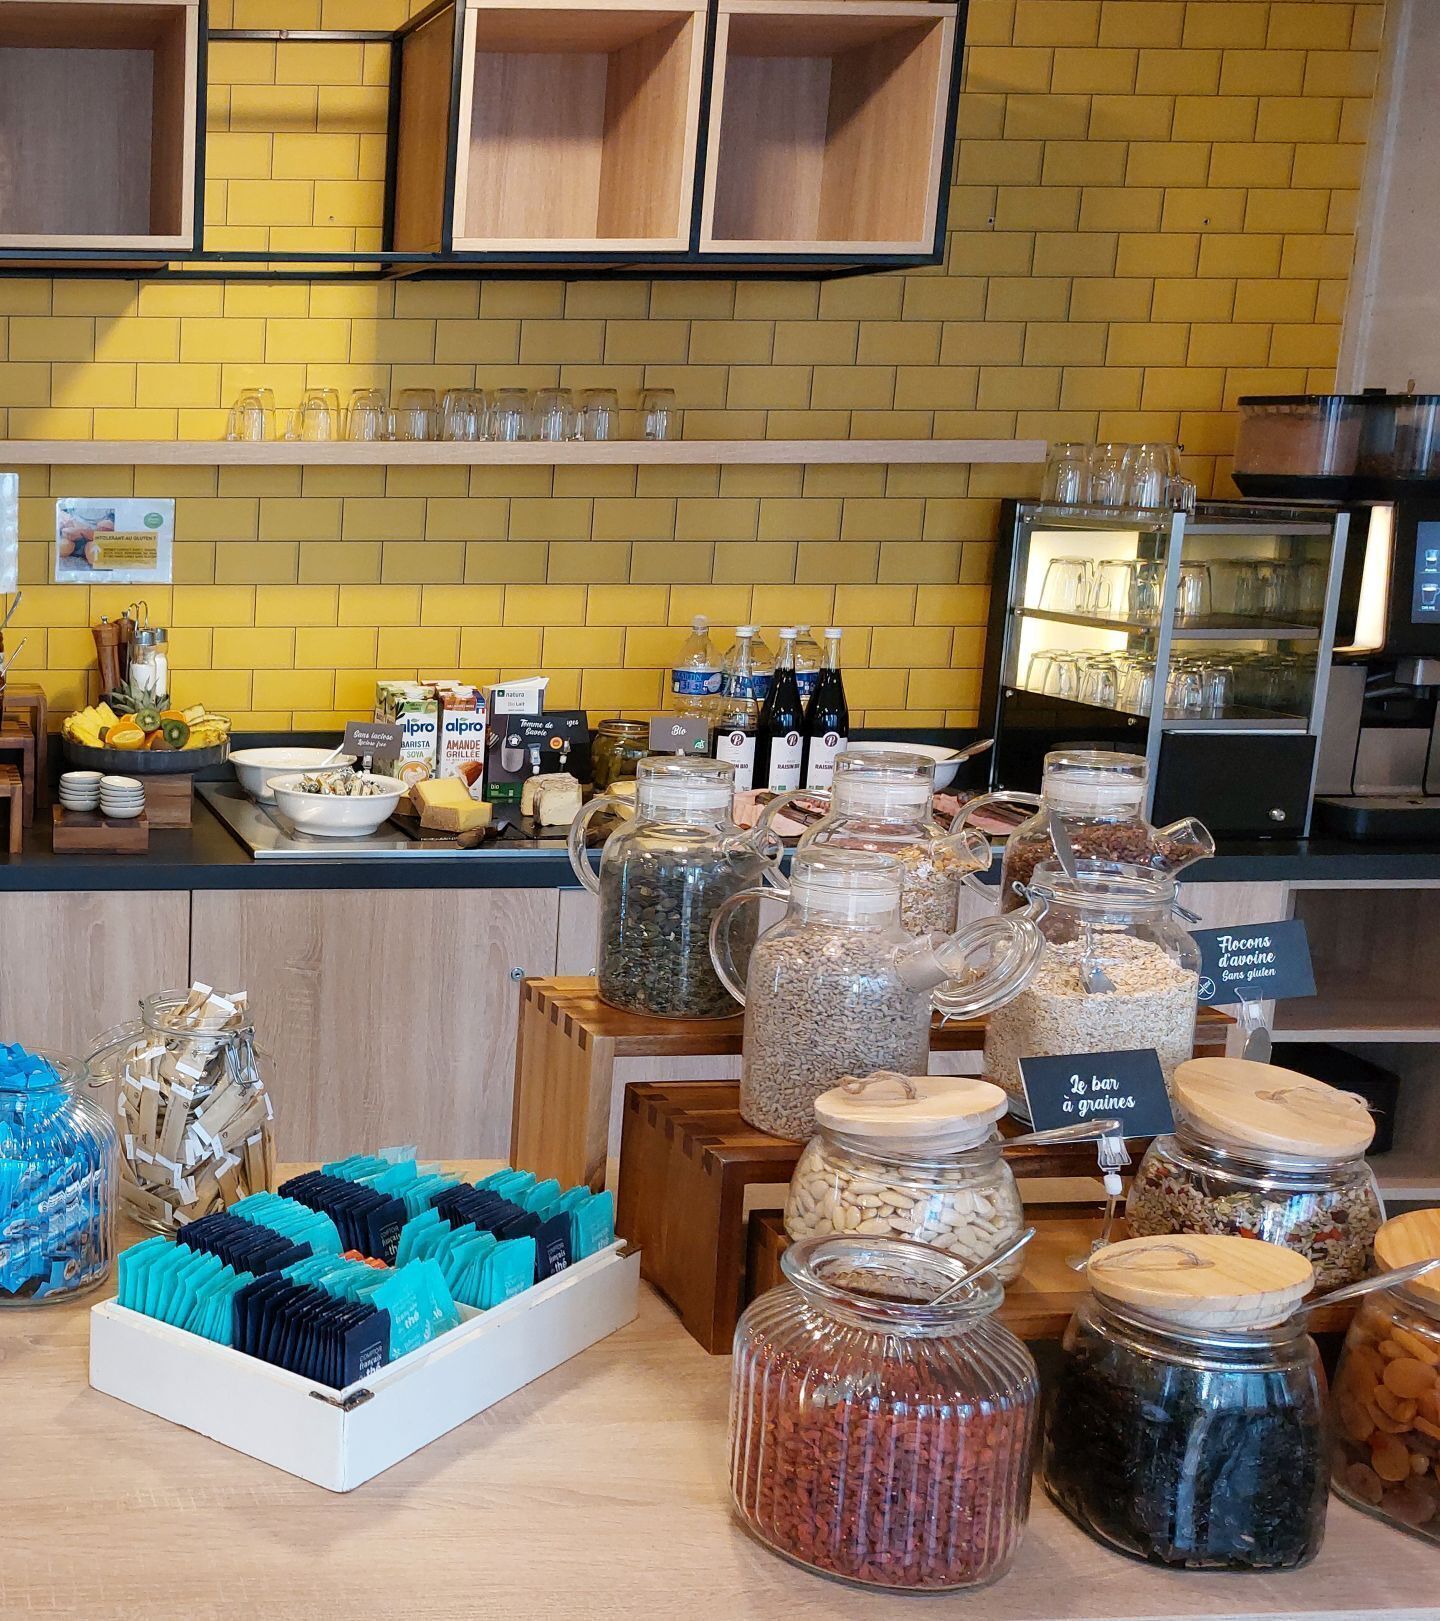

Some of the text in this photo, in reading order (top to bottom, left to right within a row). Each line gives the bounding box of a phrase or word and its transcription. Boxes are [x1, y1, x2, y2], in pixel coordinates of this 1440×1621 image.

[445, 718, 483, 735] alpro
[520, 718, 554, 729] Tomme de
[671, 724, 687, 736] Bio
[353, 729, 394, 741] Sans lactose
[525, 728, 548, 737] Savoie
[401, 740, 431, 749] BARISTA
[446, 740, 481, 750] AMANDE
[406, 750, 425, 758] SOYA
[1216, 935, 1272, 953] Flocons
[1218, 950, 1276, 968] d'avoine
[1221, 967, 1277, 982] Sans gluten
[1069, 1074, 1120, 1095] Le bar
[1062, 1094, 1136, 1117] à graines
[555, 1258, 568, 1273] thé
